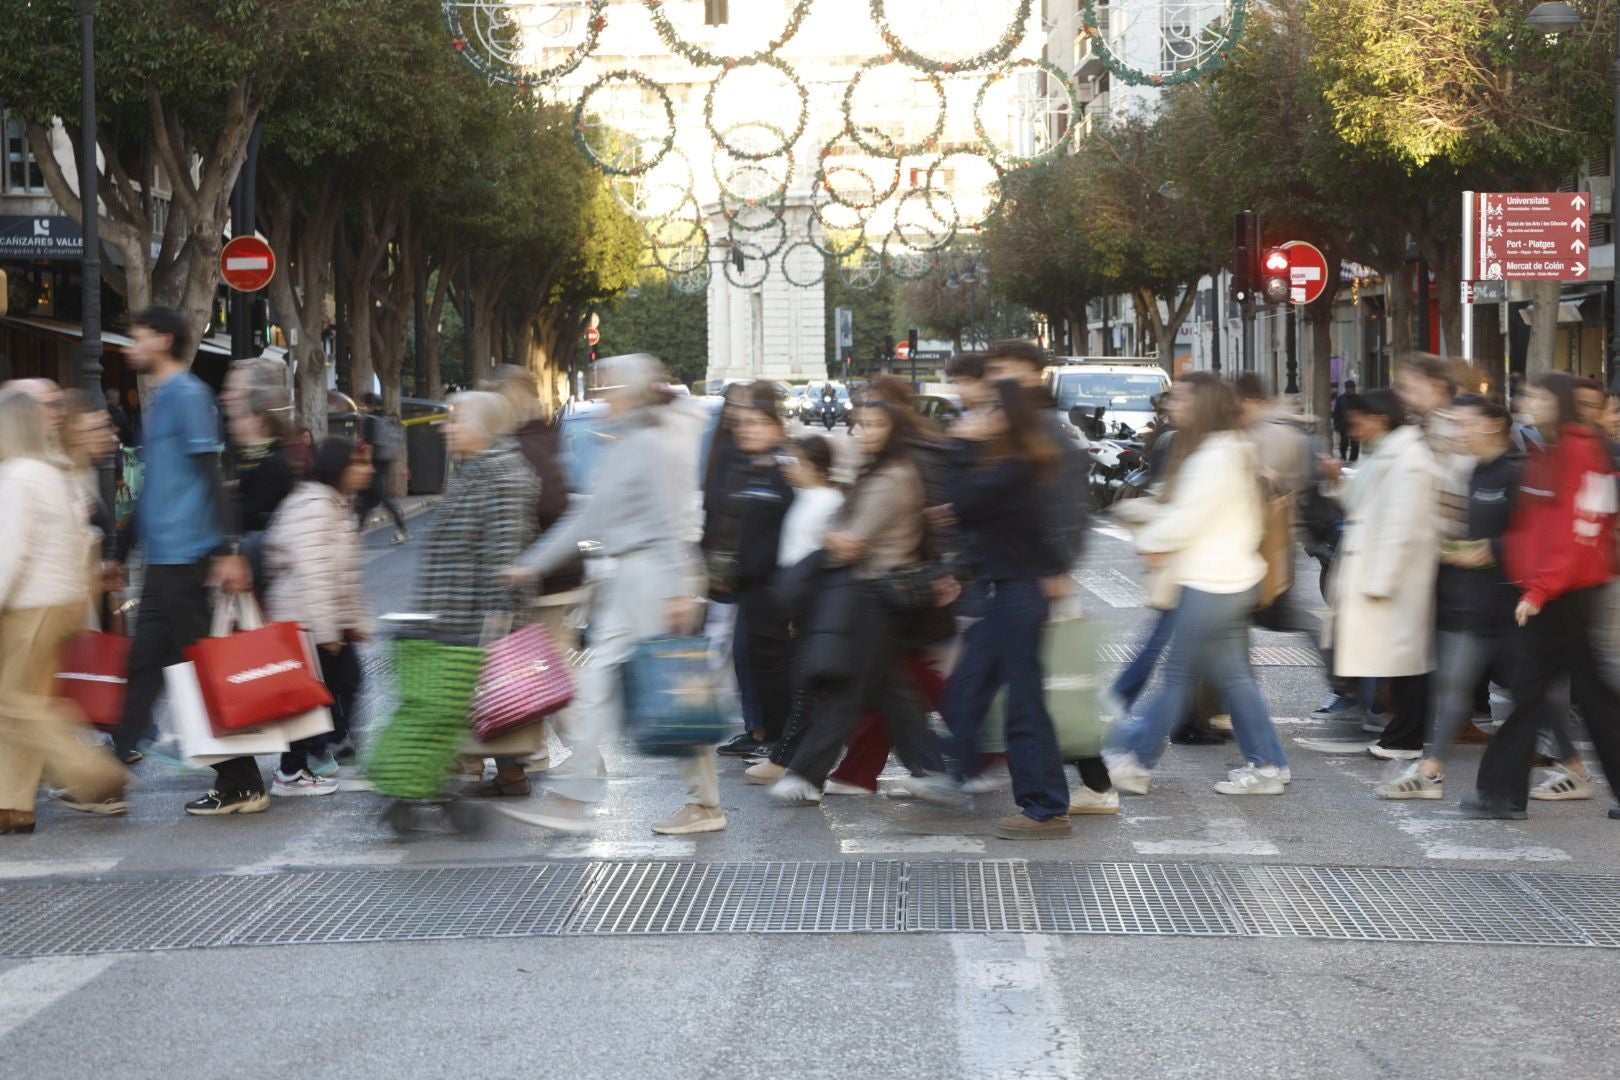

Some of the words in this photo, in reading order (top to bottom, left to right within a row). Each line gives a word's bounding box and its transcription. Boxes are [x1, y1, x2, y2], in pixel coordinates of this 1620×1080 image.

[1507, 197, 1549, 205] Universitats
[0, 236, 53, 246] CAÑIZARES
[1507, 240, 1522, 248] Port
[1528, 240, 1555, 249] Platges
[1507, 262, 1532, 270] Mercat
[1533, 262, 1543, 270] de
[1544, 261, 1565, 270] Colón
